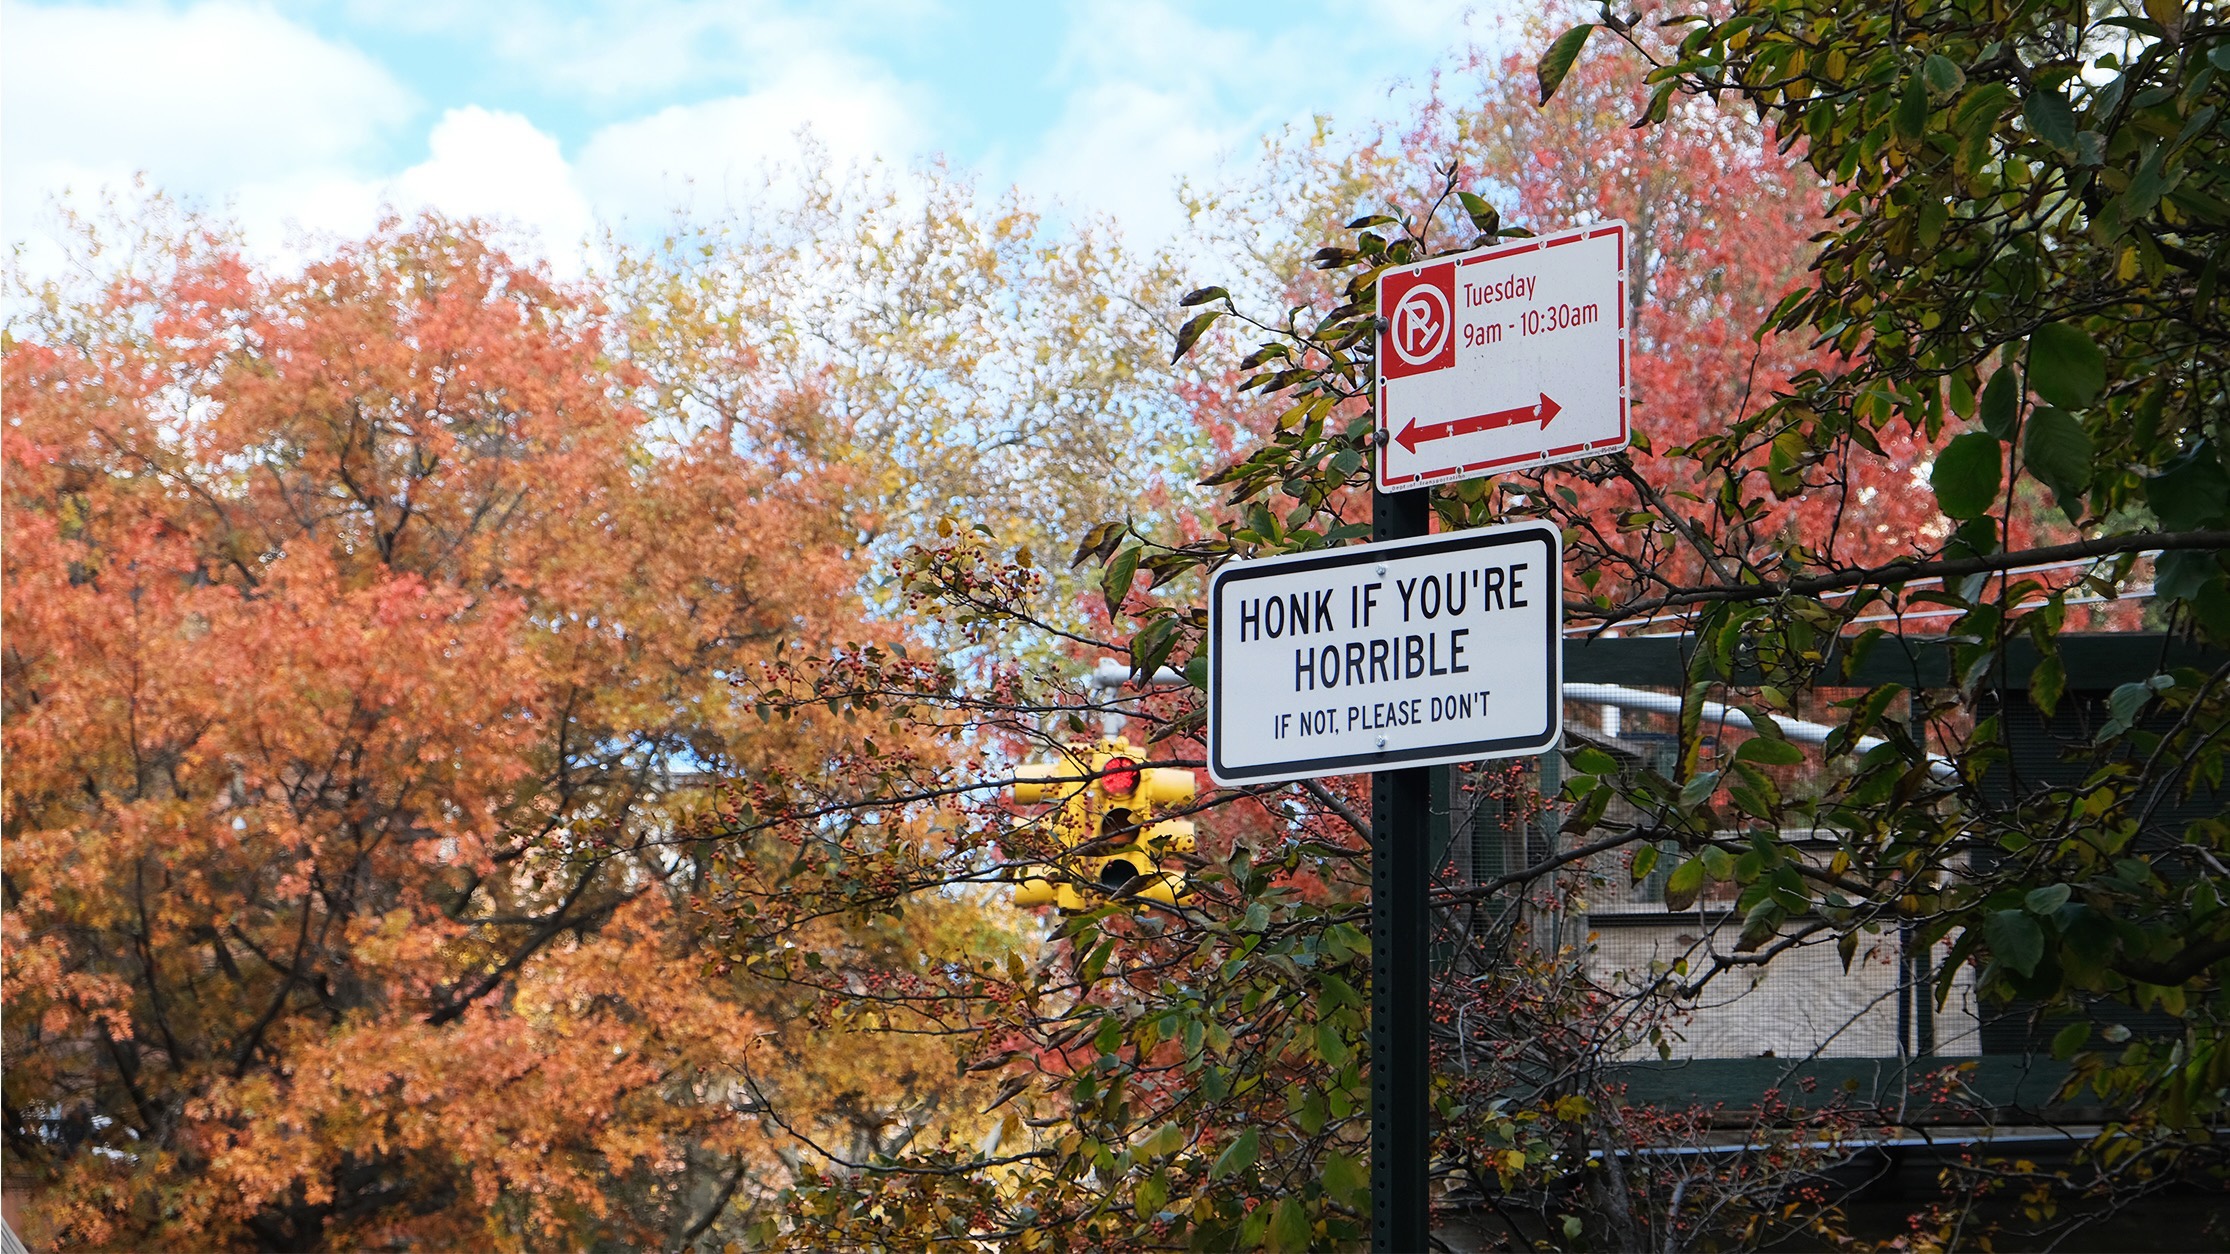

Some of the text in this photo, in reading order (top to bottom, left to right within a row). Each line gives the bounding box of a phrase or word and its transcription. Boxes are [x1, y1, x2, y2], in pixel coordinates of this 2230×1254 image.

[1463, 274, 1537, 308] Tuesday
[1463, 323, 1502, 349] 9am
[1520, 303, 1598, 337] 10:30am
[1240, 563, 1528, 643] HONK IF YOU'RE
[1295, 628, 1469, 692] HORRIBLE
[1275, 691, 1491, 740] IF NOT, PLEASE DON'T
